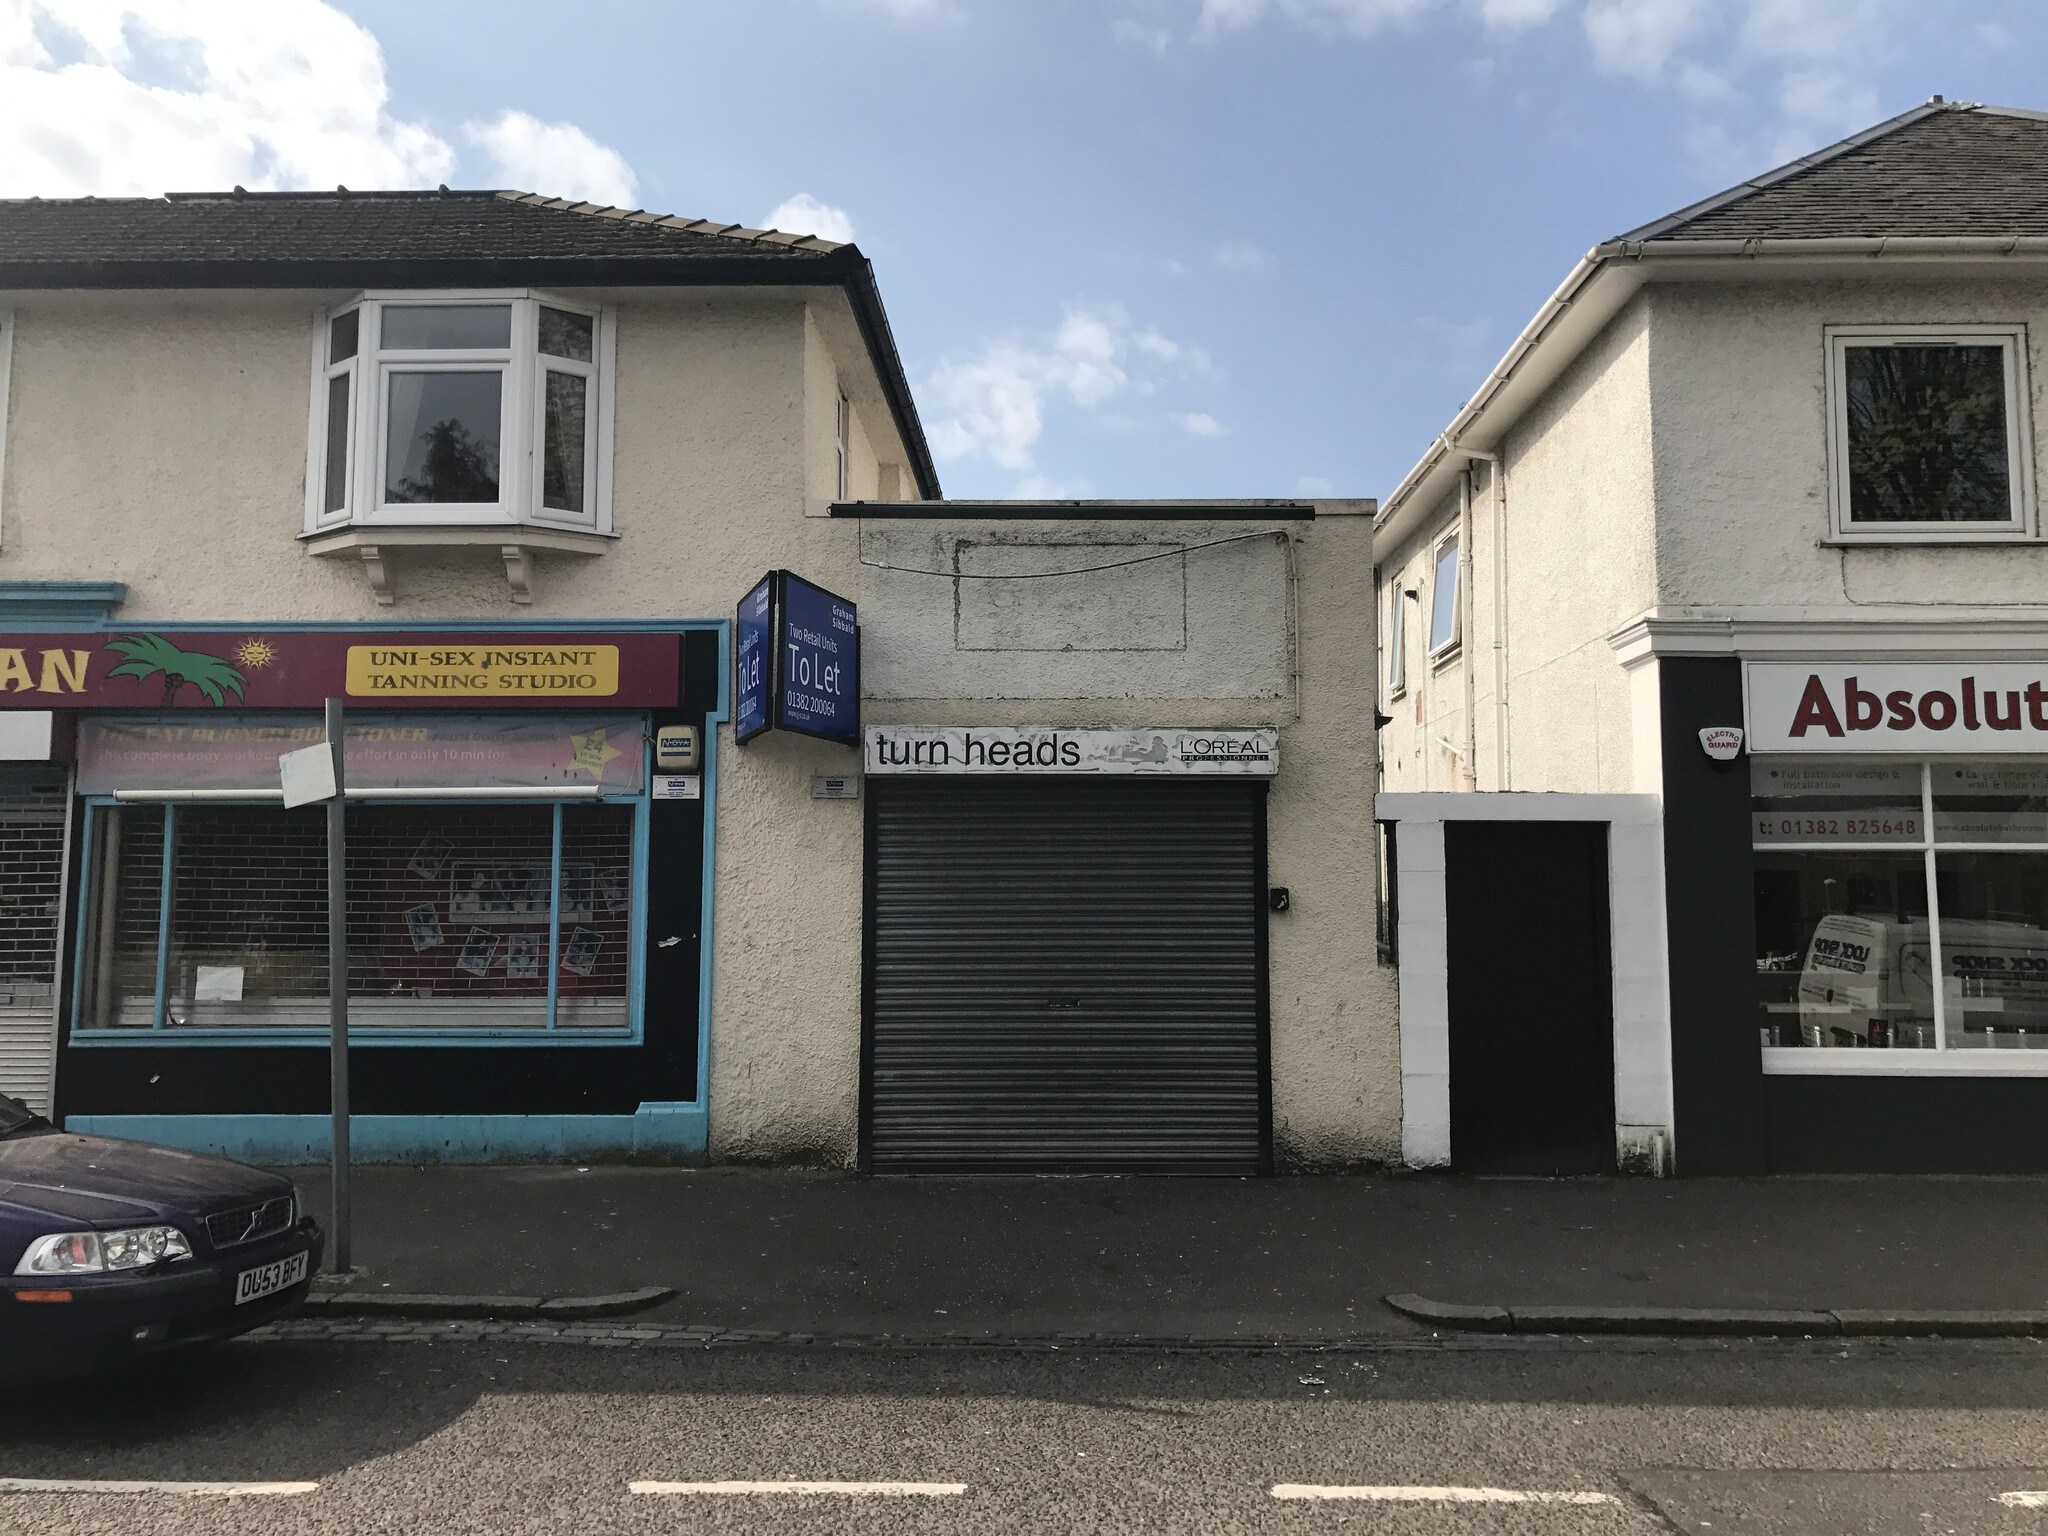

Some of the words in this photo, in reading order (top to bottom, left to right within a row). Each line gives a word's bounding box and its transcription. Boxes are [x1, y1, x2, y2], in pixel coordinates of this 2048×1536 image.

[832, 605, 854, 622] Graham
[832, 617, 854, 635] Sibbald
[789, 622, 803, 641] Two
[803, 628, 821, 648] Retail
[821, 636, 838, 654] Units
[370, 652, 475, 665] UNI-SEX
[485, 651, 597, 665] INSTANT
[747, 650, 760, 690] Let
[788, 643, 810, 686] To
[815, 653, 840, 696] Let
[368, 674, 488, 689] TANNING
[499, 674, 597, 689] STUDIO
[787, 690, 809, 710] 01382
[810, 696, 835, 717] 200064
[357, 727, 429, 742] TONER
[1706, 730, 1740, 742] ELECTRO
[876, 735, 949, 766] turn
[965, 732, 1081, 767] heads
[1180, 738, 1269, 754] L'ORÉAL
[123, 750, 184, 763] complete
[187, 749, 221, 763] body
[223, 749, 277, 761] workout
[356, 747, 392, 761] effort
[395, 749, 407, 760] in
[410, 748, 438, 762] only
[443, 748, 458, 760] 10
[460, 748, 484, 760] min
[1804, 769, 1853, 779] bathroom
[1856, 769, 1889, 780] design
[1997, 771, 2026, 781] range
[2030, 770, 2041, 779] of
[1783, 780, 1841, 790] installation
[1968, 780, 1989, 789] wall
[1993, 780, 2000, 789] &
[2004, 780, 2028, 789] floor
[1759, 820, 1773, 835] t:
[1781, 820, 1839, 835] 01382
[1846, 820, 1917, 835] 825648
[241, 1264, 281, 1298] OU53
[281, 1254, 305, 1285] BFY
